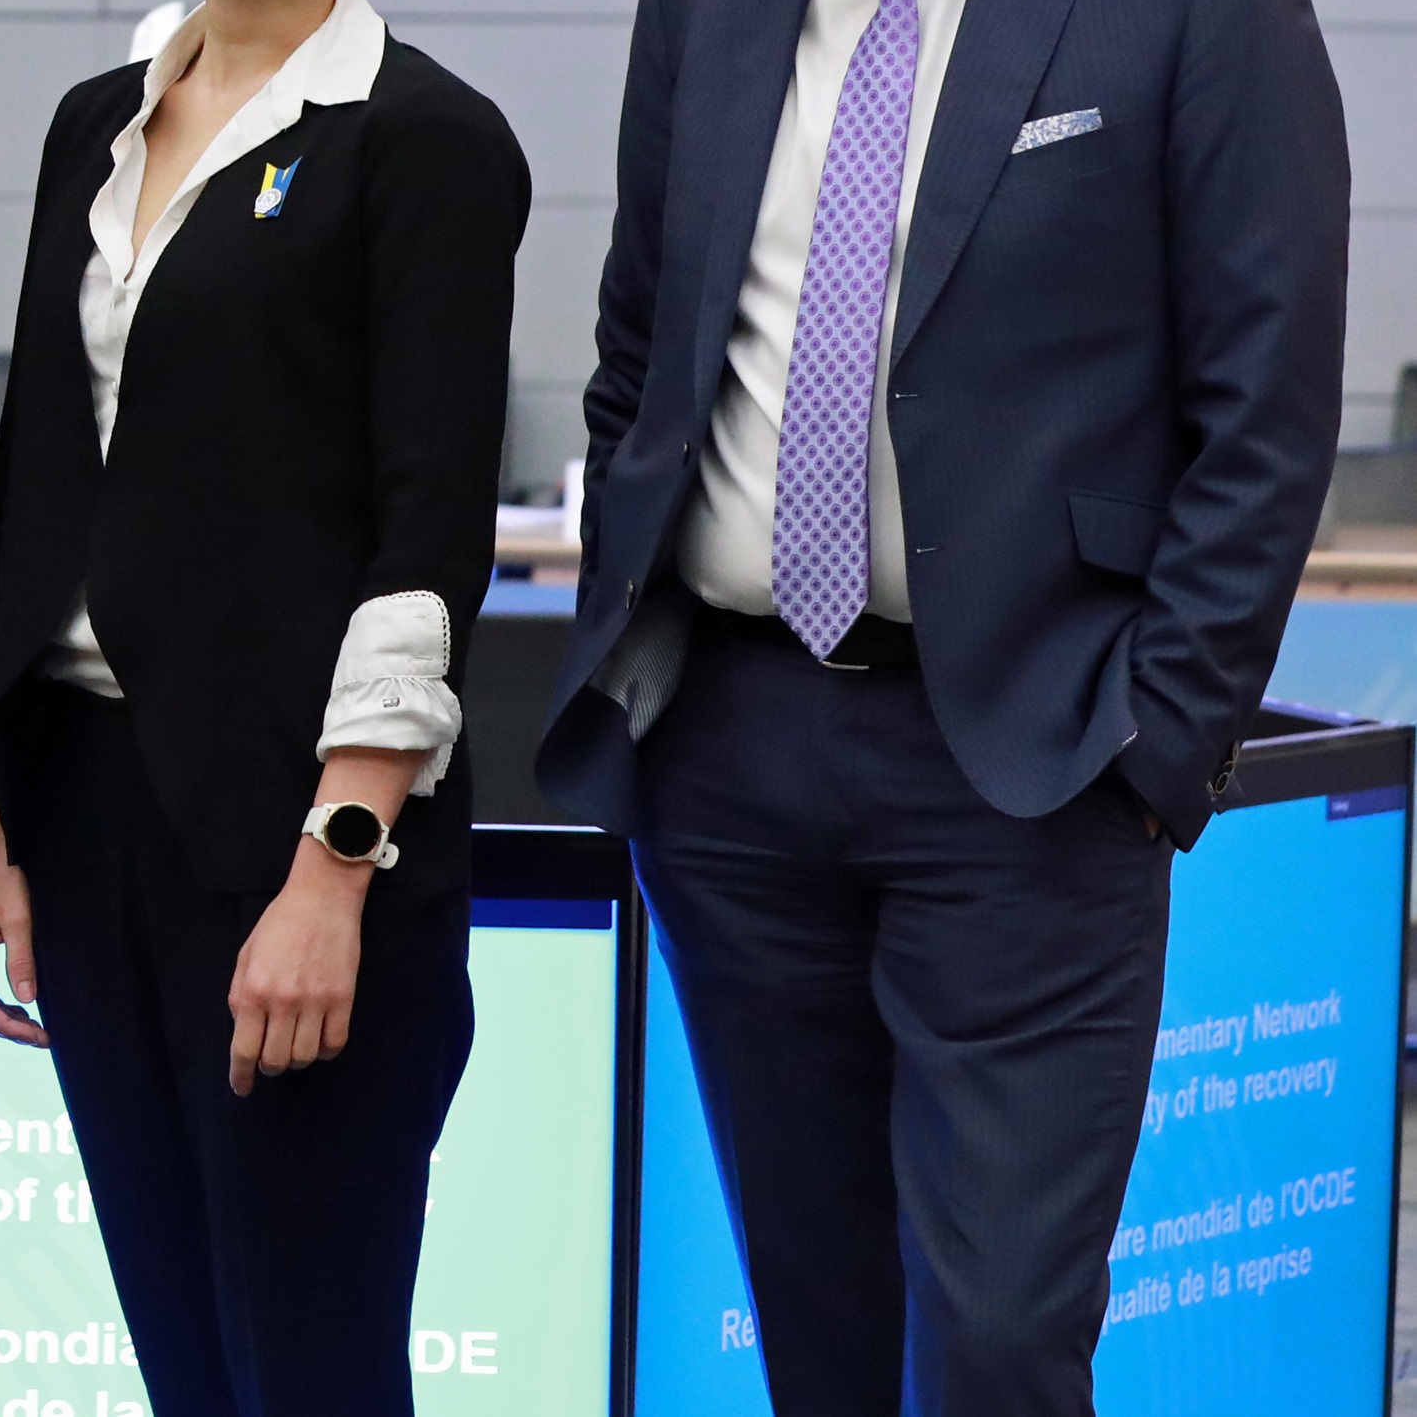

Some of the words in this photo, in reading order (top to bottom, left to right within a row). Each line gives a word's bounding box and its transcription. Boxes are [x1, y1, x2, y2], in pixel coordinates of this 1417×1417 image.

[1252, 987, 1342, 1042] Network
[1174, 1076, 1199, 1119] of
[1203, 1072, 1237, 1114] the
[1243, 1056, 1338, 1098] recovery
[1152, 1193, 1242, 1252] mondial
[1247, 1189, 1274, 1229] de
[1279, 1166, 1357, 1220] l'OCDE
[1178, 1267, 1205, 1307] de
[1211, 1260, 1230, 1298] la
[1236, 1243, 1313, 1297] reprise
[2, 1388, 75, 1417] de
